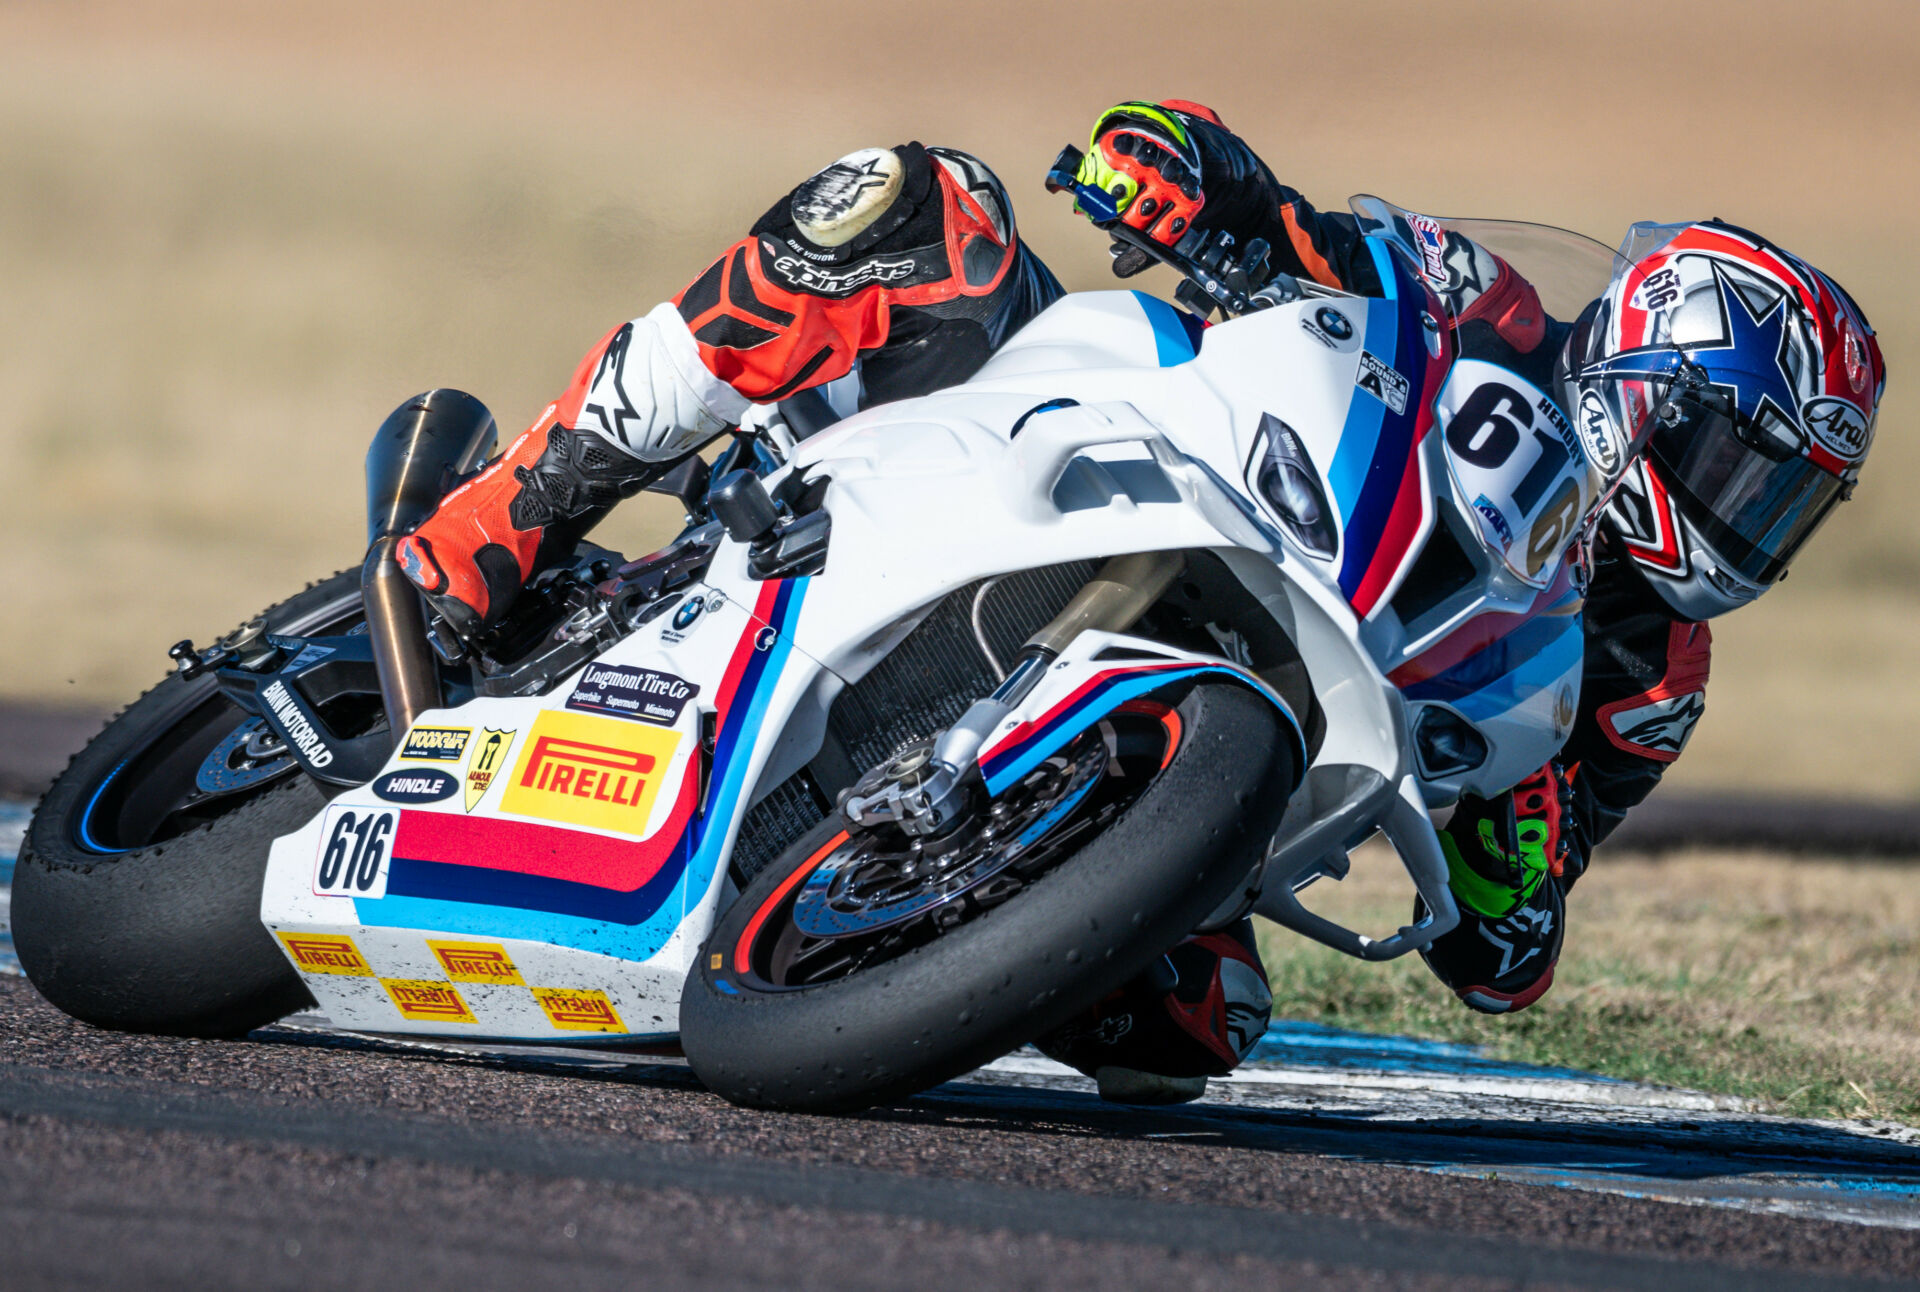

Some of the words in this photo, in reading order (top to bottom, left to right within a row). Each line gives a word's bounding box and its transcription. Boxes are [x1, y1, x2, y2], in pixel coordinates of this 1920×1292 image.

[786, 239, 803, 254] ONE
[1642, 268, 1679, 310] 616
[1359, 371, 1383, 399] A
[1361, 356, 1398, 387] ROUND
[1537, 396, 1584, 469] HENDRY
[1581, 400, 1618, 466] Arai
[1806, 405, 1867, 450] Arai
[1445, 381, 1580, 577] 616
[262, 680, 293, 714] BMW
[641, 672, 670, 696] Tire
[668, 679, 691, 700] Co
[571, 689, 602, 704] Superbike
[605, 694, 640, 711] Supermoto
[643, 703, 676, 718] Minimoto
[277, 701, 334, 768] MOTORRAD
[408, 730, 469, 750] WOODCRAFT
[386, 777, 446, 796] HINDLE
[519, 735, 657, 808] PIRELLI
[318, 811, 394, 892] 616
[287, 939, 361, 968] PIRELLI
[436, 948, 514, 977] PIRELLI
[393, 985, 466, 1016] PIRELLI
[544, 994, 618, 1026] PIRELLI
